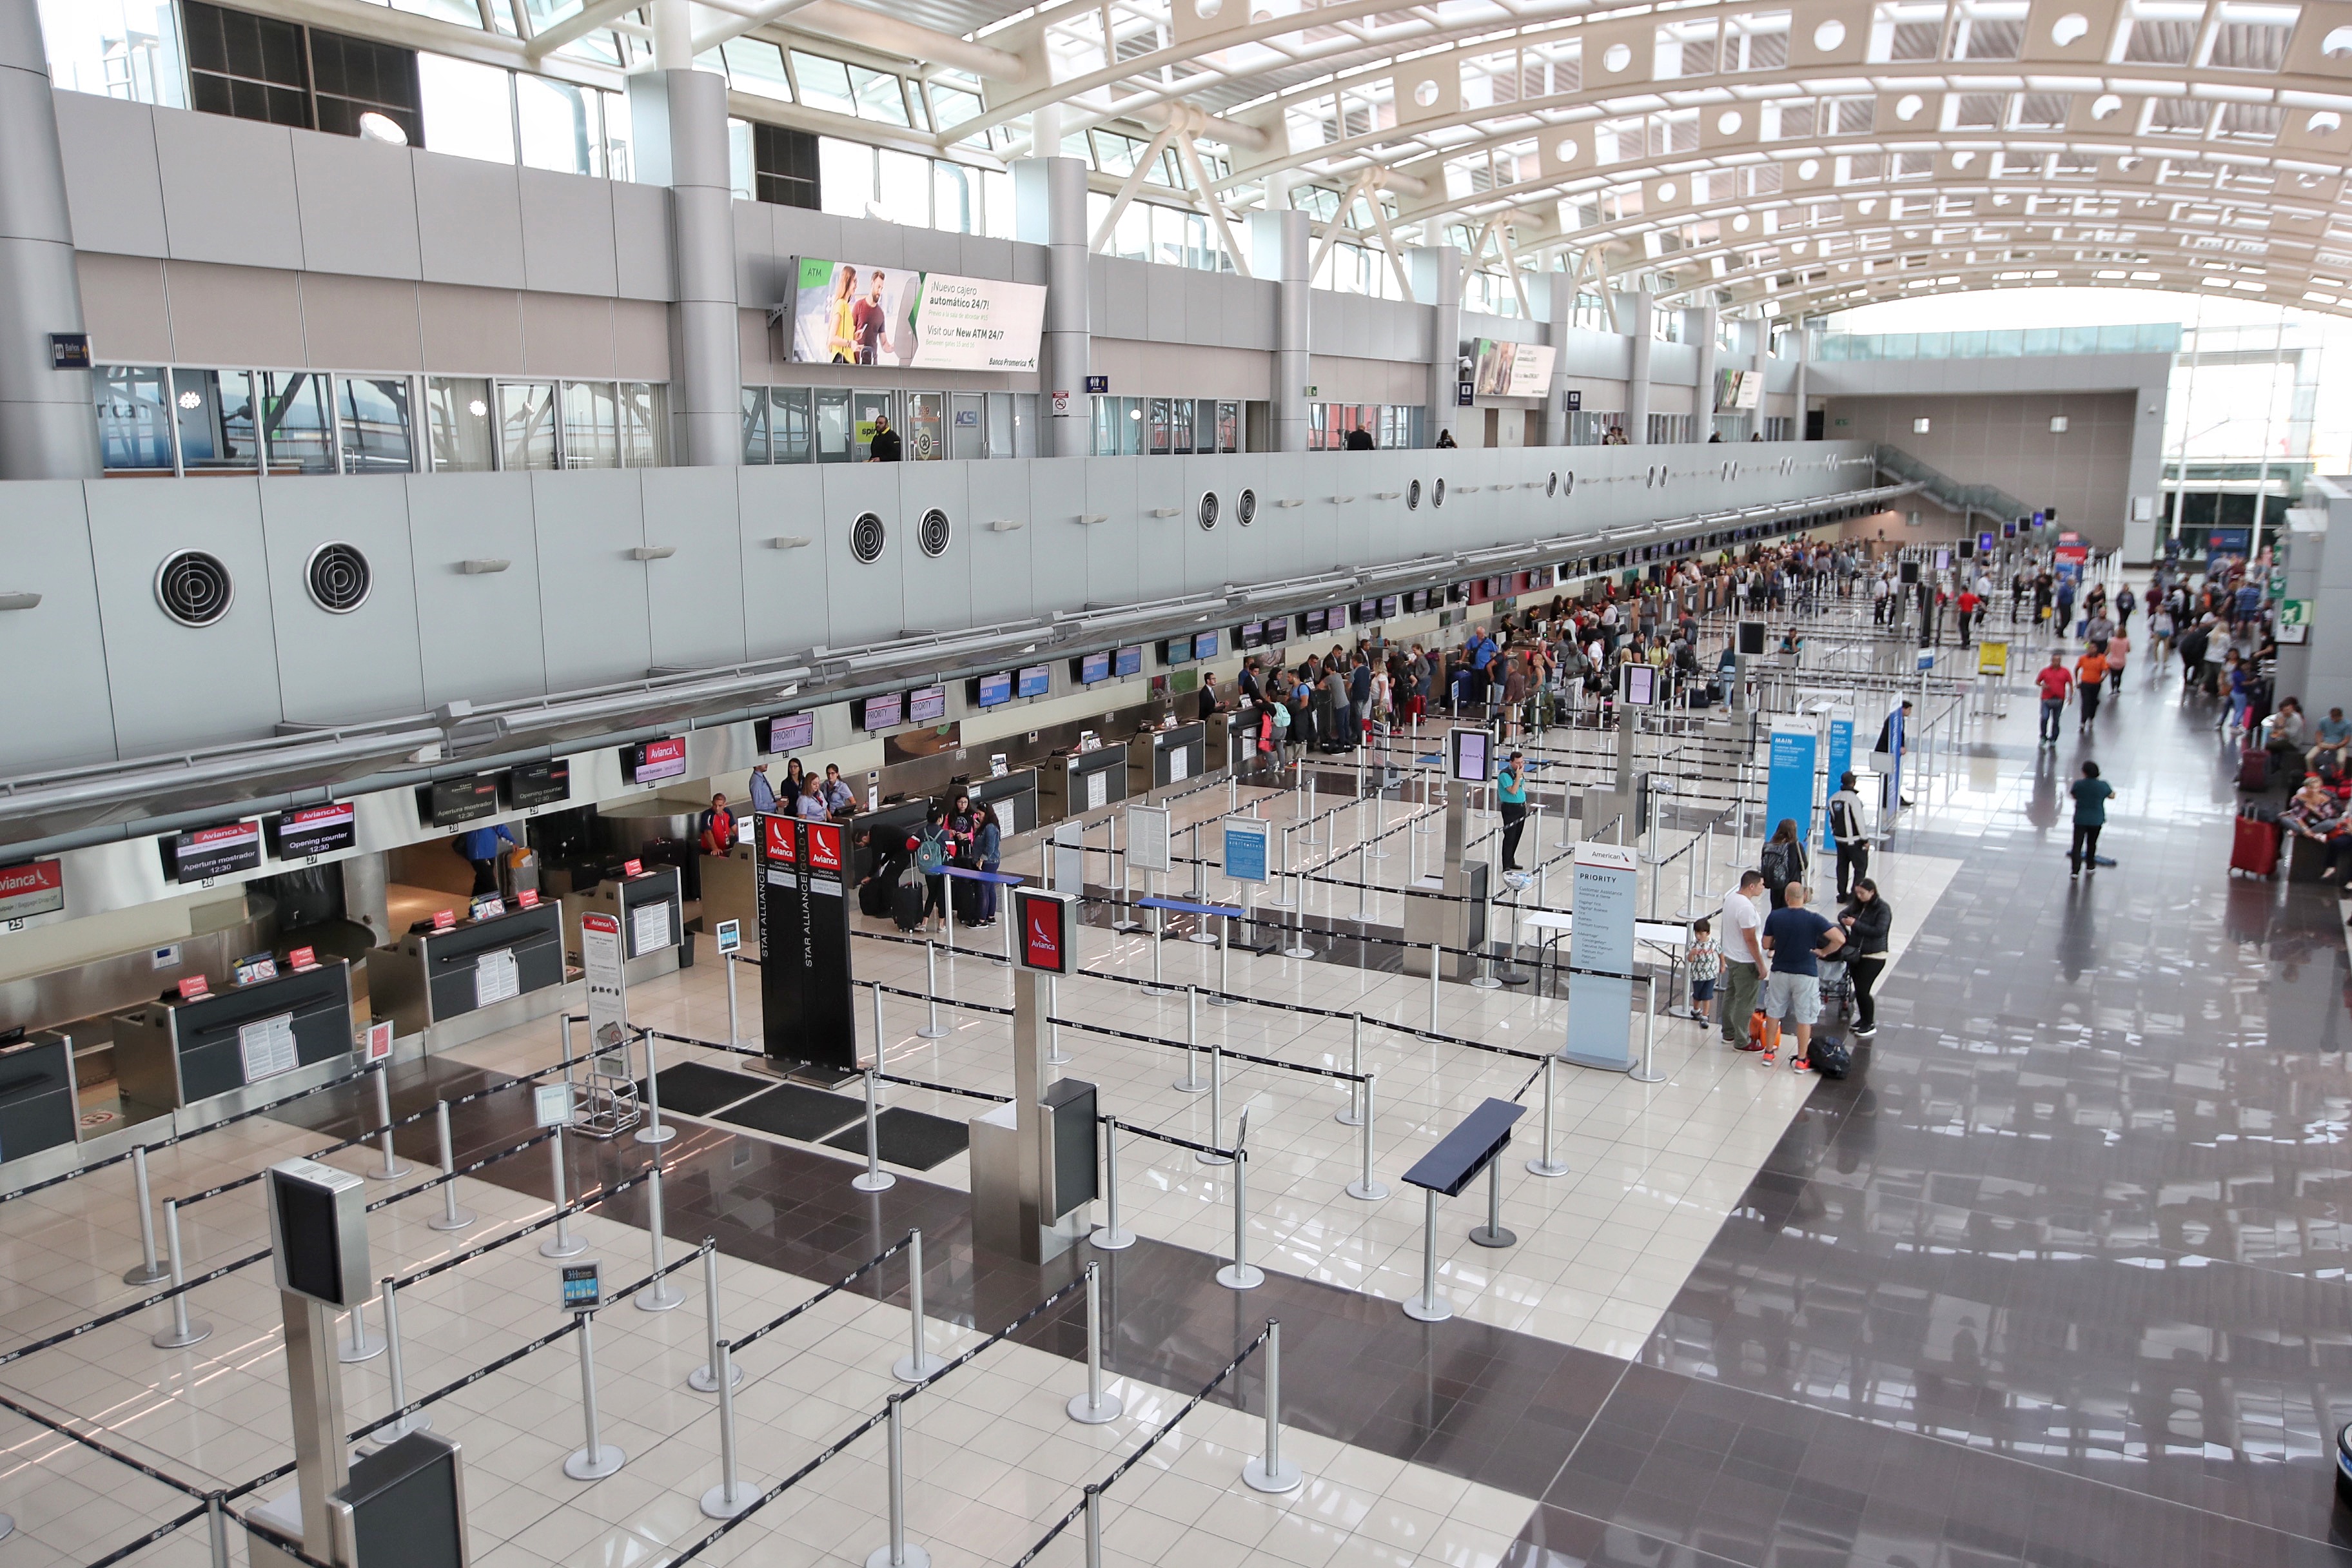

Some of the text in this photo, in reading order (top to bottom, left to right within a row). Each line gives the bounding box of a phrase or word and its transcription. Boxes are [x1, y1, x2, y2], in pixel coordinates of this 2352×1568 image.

[808, 268, 821, 277] ATM
[931, 281, 977, 297] ¡Nuevo cajero
[930, 297, 989, 309] automático 24/7!
[928, 325, 941, 335] Visit
[956, 327, 971, 337] New
[972, 329, 987, 338] ATM
[988, 330, 1004, 340] 24/7
[955, 411, 977, 424] ACSI
[1021, 680, 1032, 688] MAIN
[981, 689, 992, 698] MAIN
[912, 700, 931, 712] PRIORITY
[867, 709, 887, 720] PRIORITY
[774, 729, 796, 741] PRIORITY
[651, 747, 672, 759] Avianca
[302, 808, 335, 819] Avianca
[438, 801, 493, 816] Apertura mostrador
[450, 823, 458, 832] 28
[202, 828, 237, 840] Avianca
[289, 832, 348, 849] Opening counter
[309, 843, 329, 852] 12:30
[770, 846, 793, 857] Avianca
[184, 850, 255, 871] Apertura mostrador
[308, 854, 317, 863] 27
[813, 854, 838, 865] Avianca
[1592, 851, 1620, 860] American
[210, 864, 231, 874] 12:30
[0, 874, 35, 890] vianca
[202, 877, 213, 887] 26
[1580, 873, 1617, 883] PRIORITY
[758, 867, 767, 925] ALLIANCE
[801, 876, 810, 934] ALLIANCE
[10, 918, 23, 930] 25
[1032, 939, 1055, 950] Avianca
[804, 937, 812, 967] STAR
